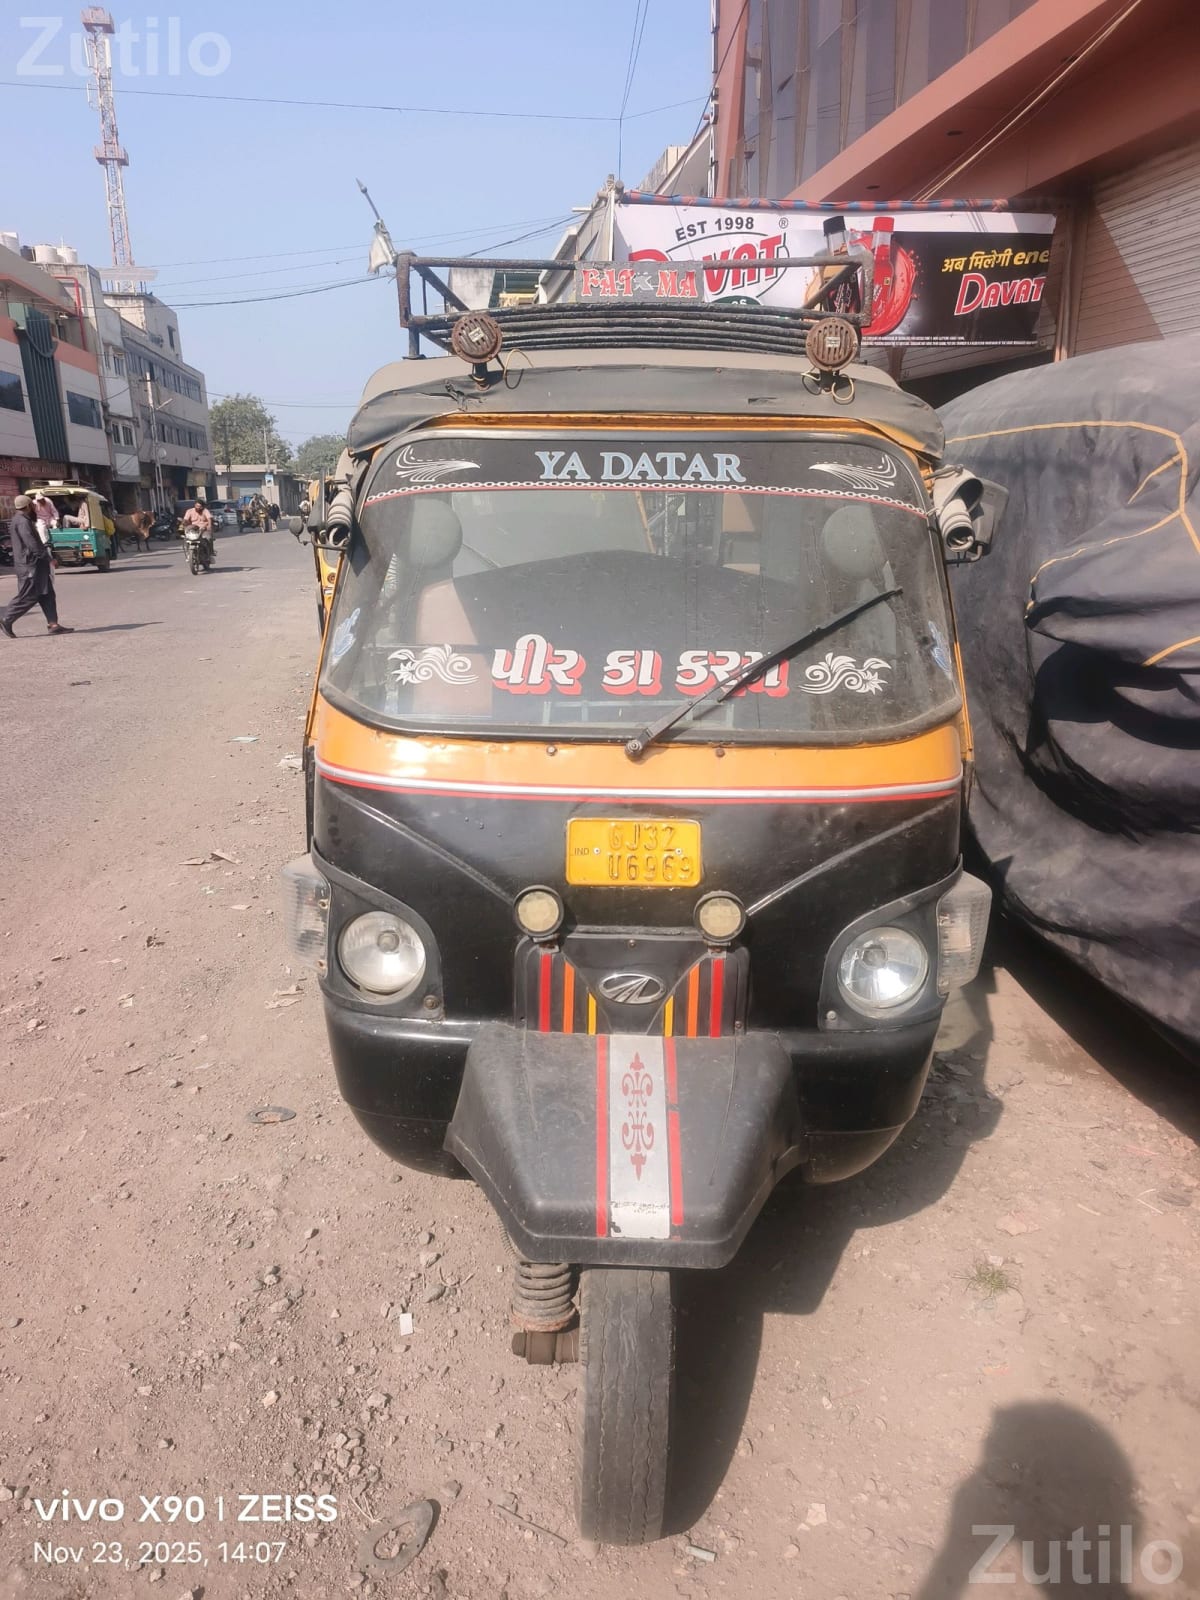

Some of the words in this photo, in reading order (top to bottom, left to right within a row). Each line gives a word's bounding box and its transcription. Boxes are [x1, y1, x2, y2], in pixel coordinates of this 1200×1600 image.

[675, 220, 707, 242] EST
[714, 216, 754, 232] 1998
[628, 231, 787, 296] VAT
[942, 256, 967, 273] अब
[968, 248, 1013, 271] मिलेगी
[534, 451, 591, 480] YA
[599, 451, 747, 483] DATAR
[491, 633, 586, 695] પીર
[601, 649, 662, 696] કા
[574, 847, 590, 856] IND
[609, 822, 676, 852] GJ32
